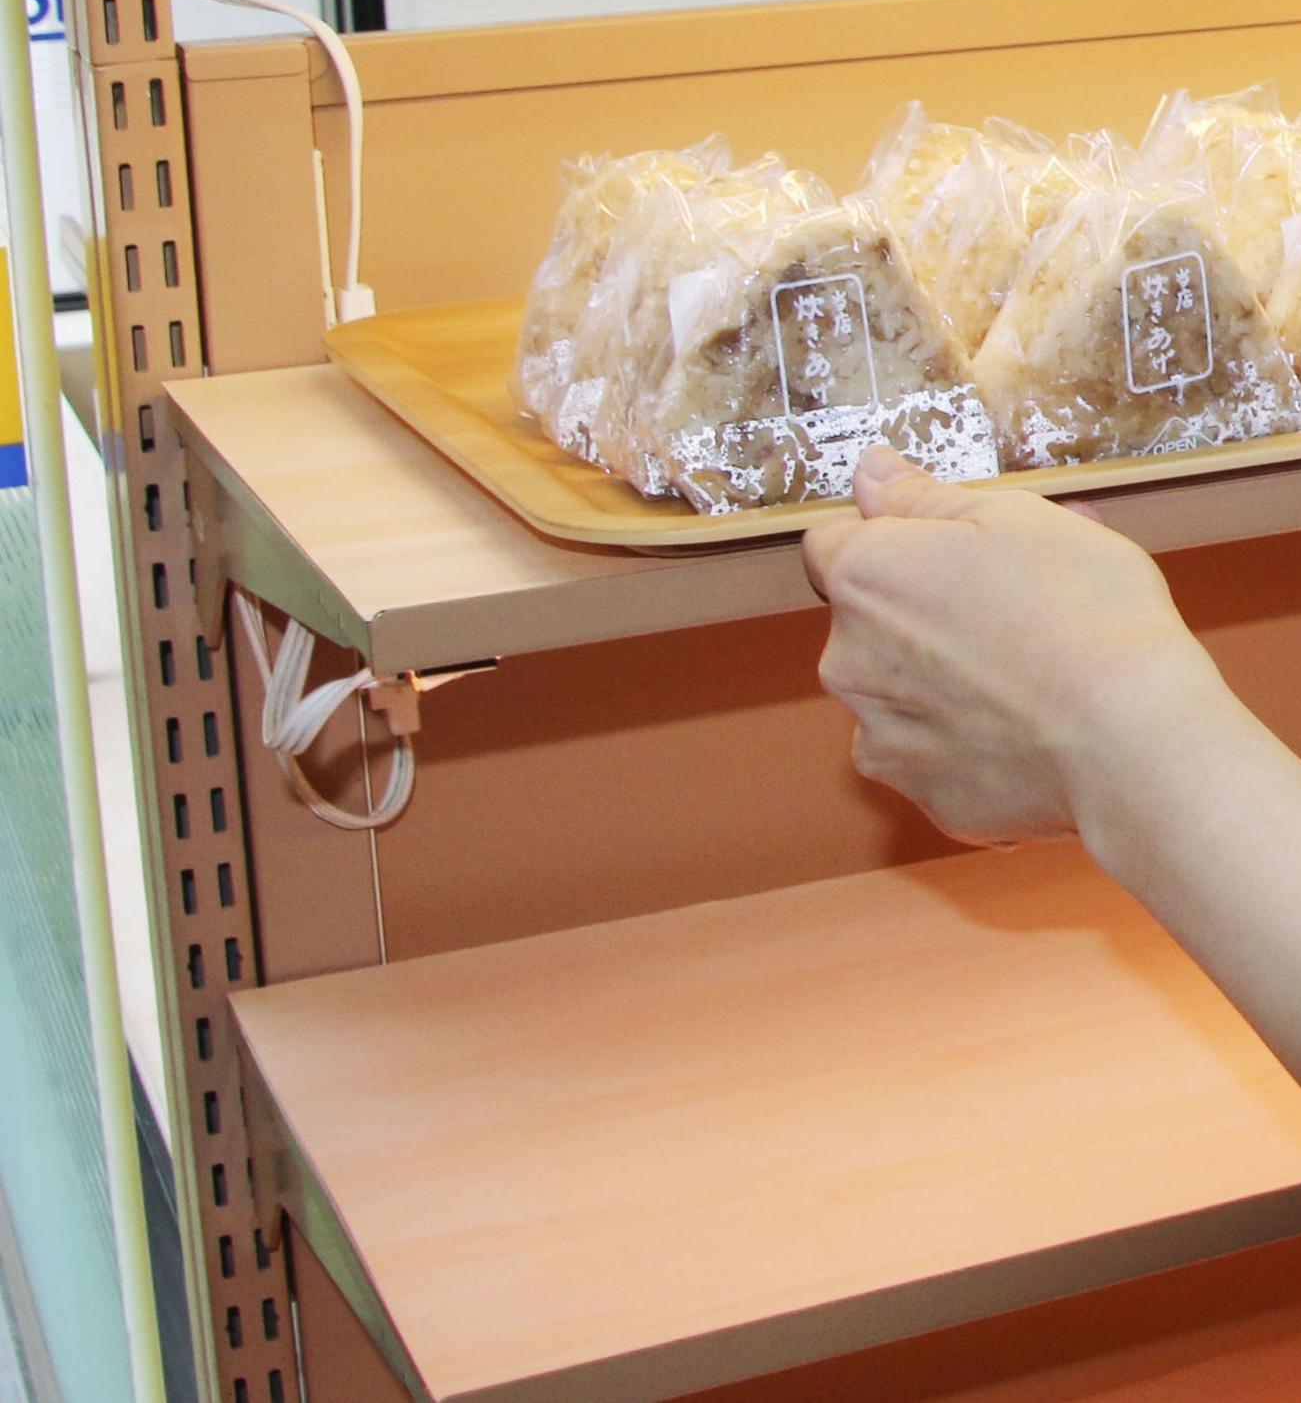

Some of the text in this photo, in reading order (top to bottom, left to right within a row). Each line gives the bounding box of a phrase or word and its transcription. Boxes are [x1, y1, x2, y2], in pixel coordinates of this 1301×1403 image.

[1141, 274, 1175, 375] 炊きあげ
[1175, 268, 1194, 312] 当店
[794, 294, 836, 405] 炊きあげ
[1153, 437, 1198, 455] OPEN
